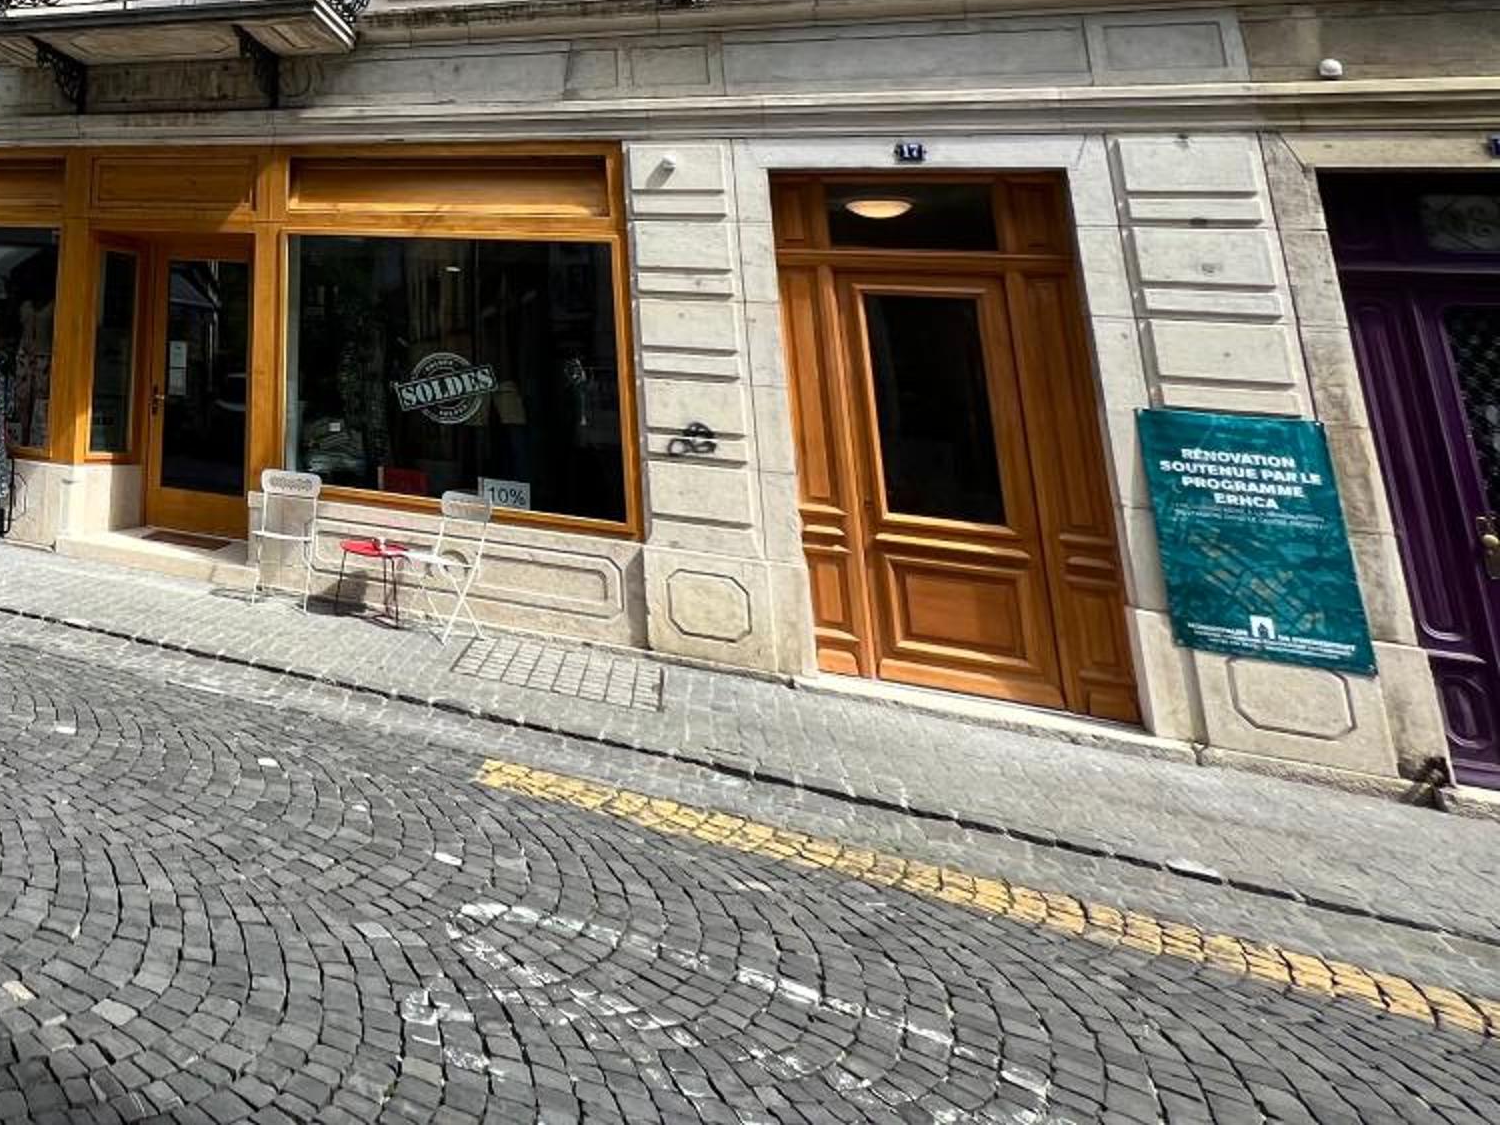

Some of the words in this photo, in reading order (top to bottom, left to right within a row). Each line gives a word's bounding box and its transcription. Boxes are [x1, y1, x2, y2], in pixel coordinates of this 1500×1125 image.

[903, 144, 918, 157] 17
[401, 368, 494, 407] SOLDES
[1159, 460, 1257, 480] SOUTENUE
[1261, 469, 1298, 483] PAR
[1300, 473, 1322, 485] LE
[488, 486, 527, 506] 10%
[1181, 477, 1305, 497] PROGRAMME
